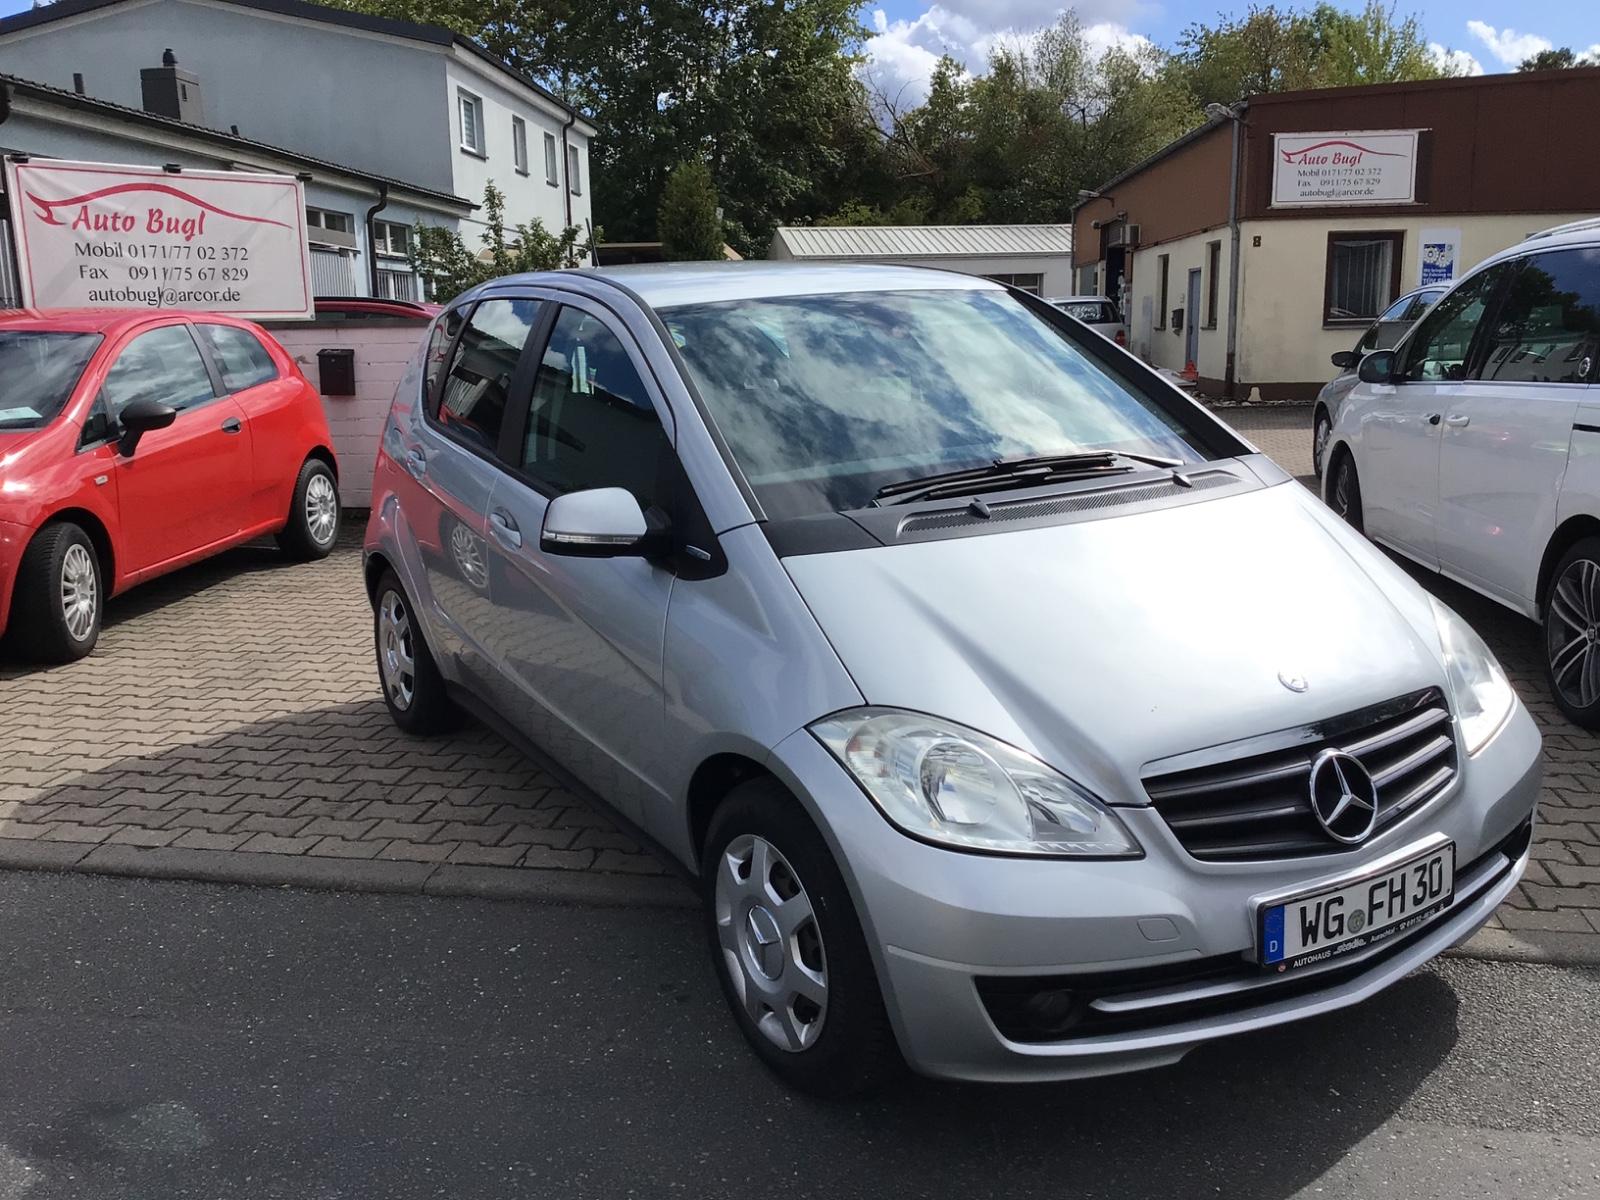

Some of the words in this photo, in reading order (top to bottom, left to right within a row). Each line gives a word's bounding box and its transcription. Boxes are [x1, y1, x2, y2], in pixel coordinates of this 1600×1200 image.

[1298, 153, 1328, 165] Auto
[1332, 152, 1363, 167] Bugl
[1297, 169, 1320, 177] Mobil
[1355, 168, 1365, 176] 02
[72, 205, 136, 232] Auto
[146, 208, 206, 241] Bugl
[1253, 235, 1262, 247] 8
[74, 242, 123, 258] Mobil
[128, 244, 191, 259] 0171/77
[197, 246, 216, 260] 02
[221, 247, 248, 261] 372
[79, 264, 109, 280] Fax
[128, 266, 192, 281] 0911/75
[197, 267, 216, 281] 67
[222, 268, 248, 281] 829
[88, 286, 241, 307] autobugl@arcor.de
[1300, 895, 1345, 947] WG
[1367, 872, 1406, 926] FH
[1413, 856, 1443, 906] 30
[1269, 940, 1278, 953] D
[1293, 950, 1332, 968] AUTOHAUS
